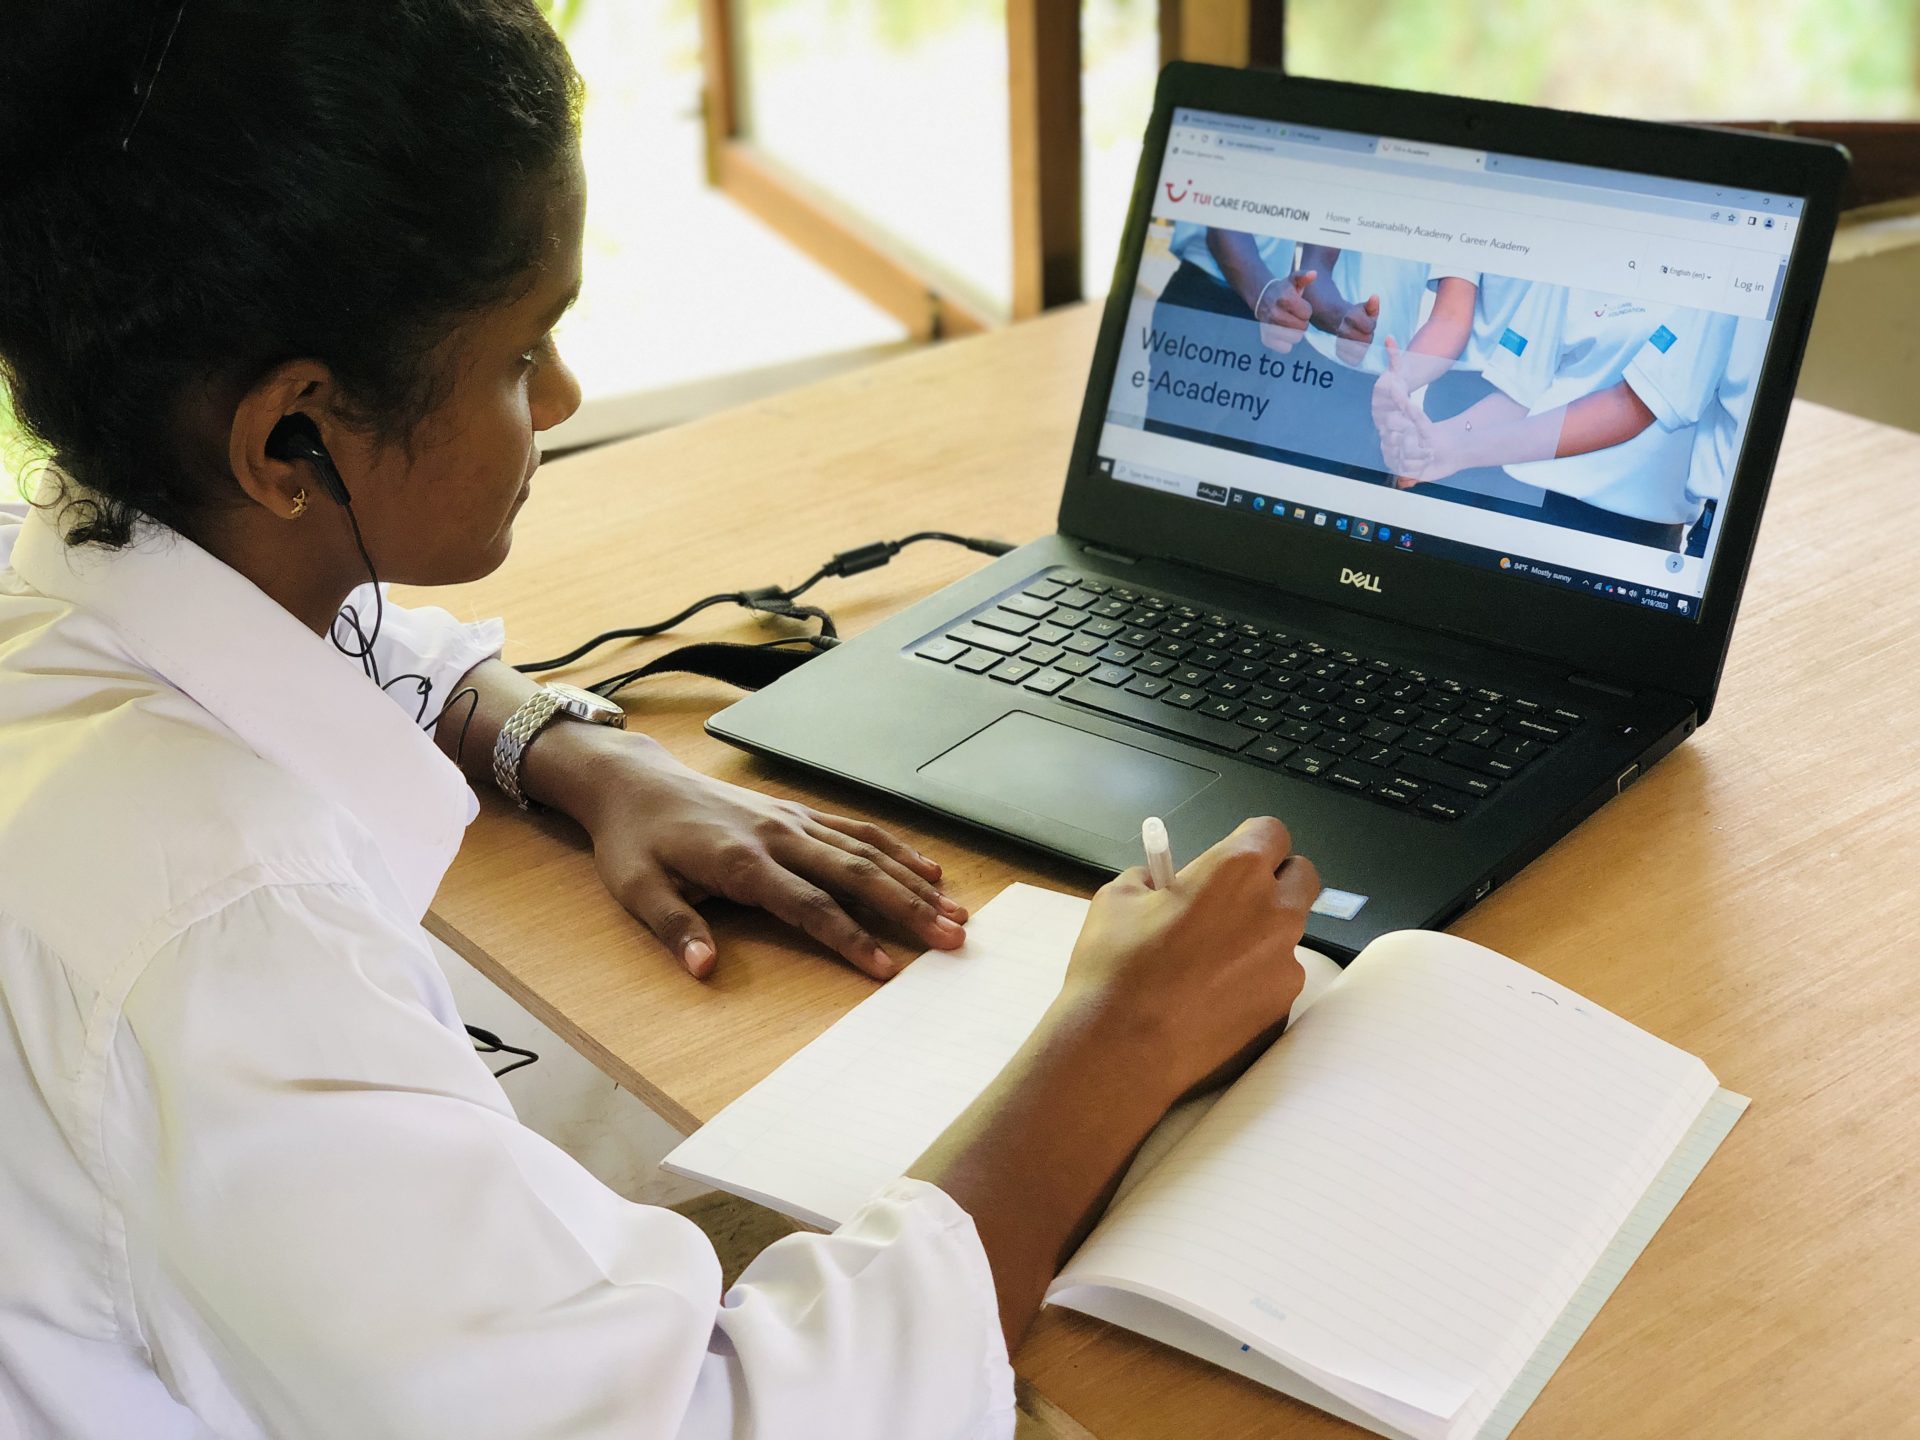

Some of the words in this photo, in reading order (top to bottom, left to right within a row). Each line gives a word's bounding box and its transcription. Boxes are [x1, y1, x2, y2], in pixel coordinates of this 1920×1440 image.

[1193, 192, 1212, 205] TUI
[1213, 195, 1239, 211] CARE
[1241, 201, 1310, 221] FOUNDATION
[1326, 211, 1350, 225] Home
[1357, 216, 1413, 236] Sustainability
[1413, 226, 1454, 242] Academy
[1459, 232, 1488, 247] Career
[1489, 238, 1530, 255] Academy
[1669, 266, 1692, 277] English
[1734, 277, 1753, 292] Log
[1755, 281, 1764, 292] in
[1141, 327, 1251, 371] Welcome
[1258, 353, 1285, 378] to
[1292, 360, 1334, 389] the
[1131, 370, 1270, 421] e-Academy
[1340, 568, 1382, 593] DELL
[1531, 566, 1552, 579] Mostly
[1552, 573, 1572, 583] sunny
[1222, 682, 1236, 690] H
[1216, 704, 1230, 712] N
[1254, 715, 1268, 723] M
